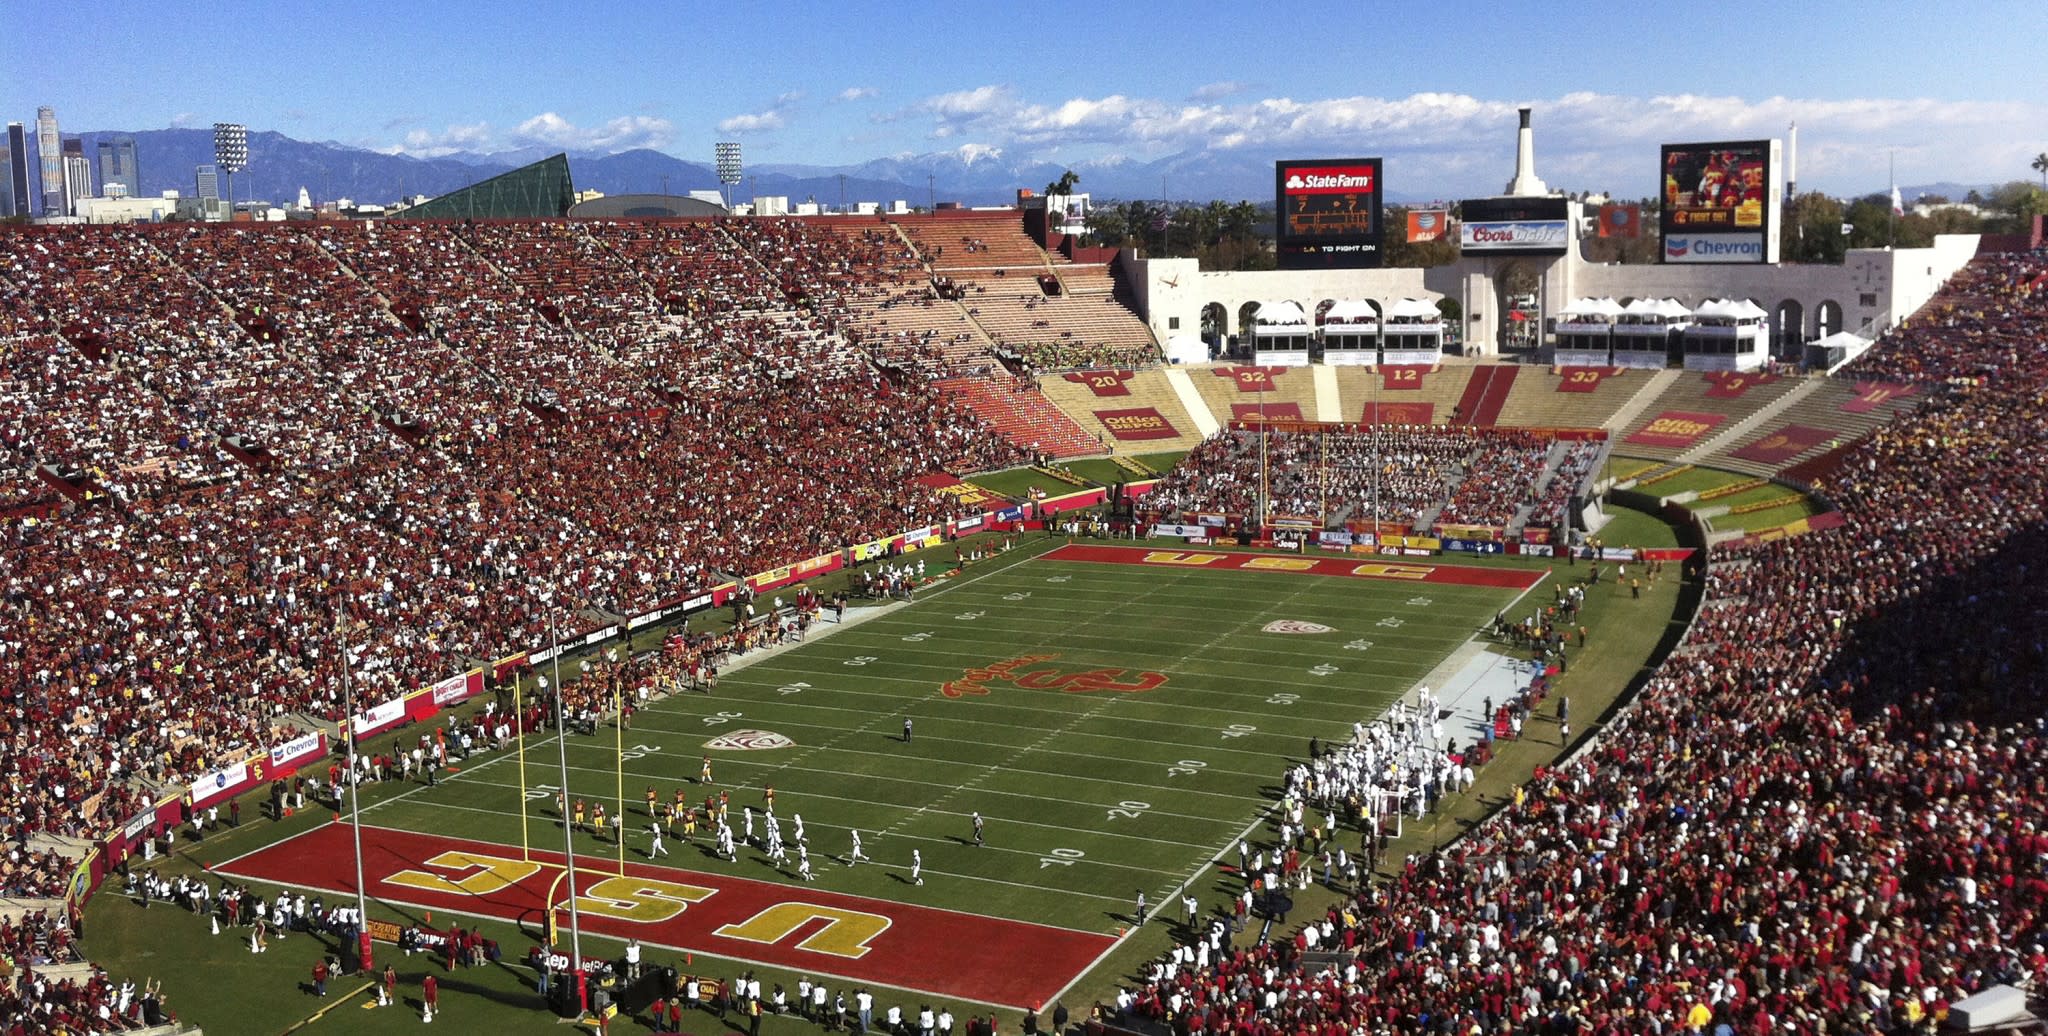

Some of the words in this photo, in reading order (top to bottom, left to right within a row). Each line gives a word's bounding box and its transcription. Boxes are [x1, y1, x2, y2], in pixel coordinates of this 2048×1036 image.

[1473, 226, 1513, 242] Coors
[1693, 239, 1761, 255] Chevron
[1240, 371, 1266, 382] 32
[1394, 369, 1417, 380] 12
[1091, 376, 1118, 388] 20
[1726, 378, 1744, 391] 3
[1105, 416, 1161, 425] Office
[1110, 421, 1163, 430] DEPOT
[1277, 540, 1299, 550] Jeep
[1222, 724, 1257, 738] 40
[286, 736, 317, 756] Chevron
[1168, 759, 1208, 775] 30
[1107, 800, 1152, 819] 20
[1040, 848, 1085, 867] 10
